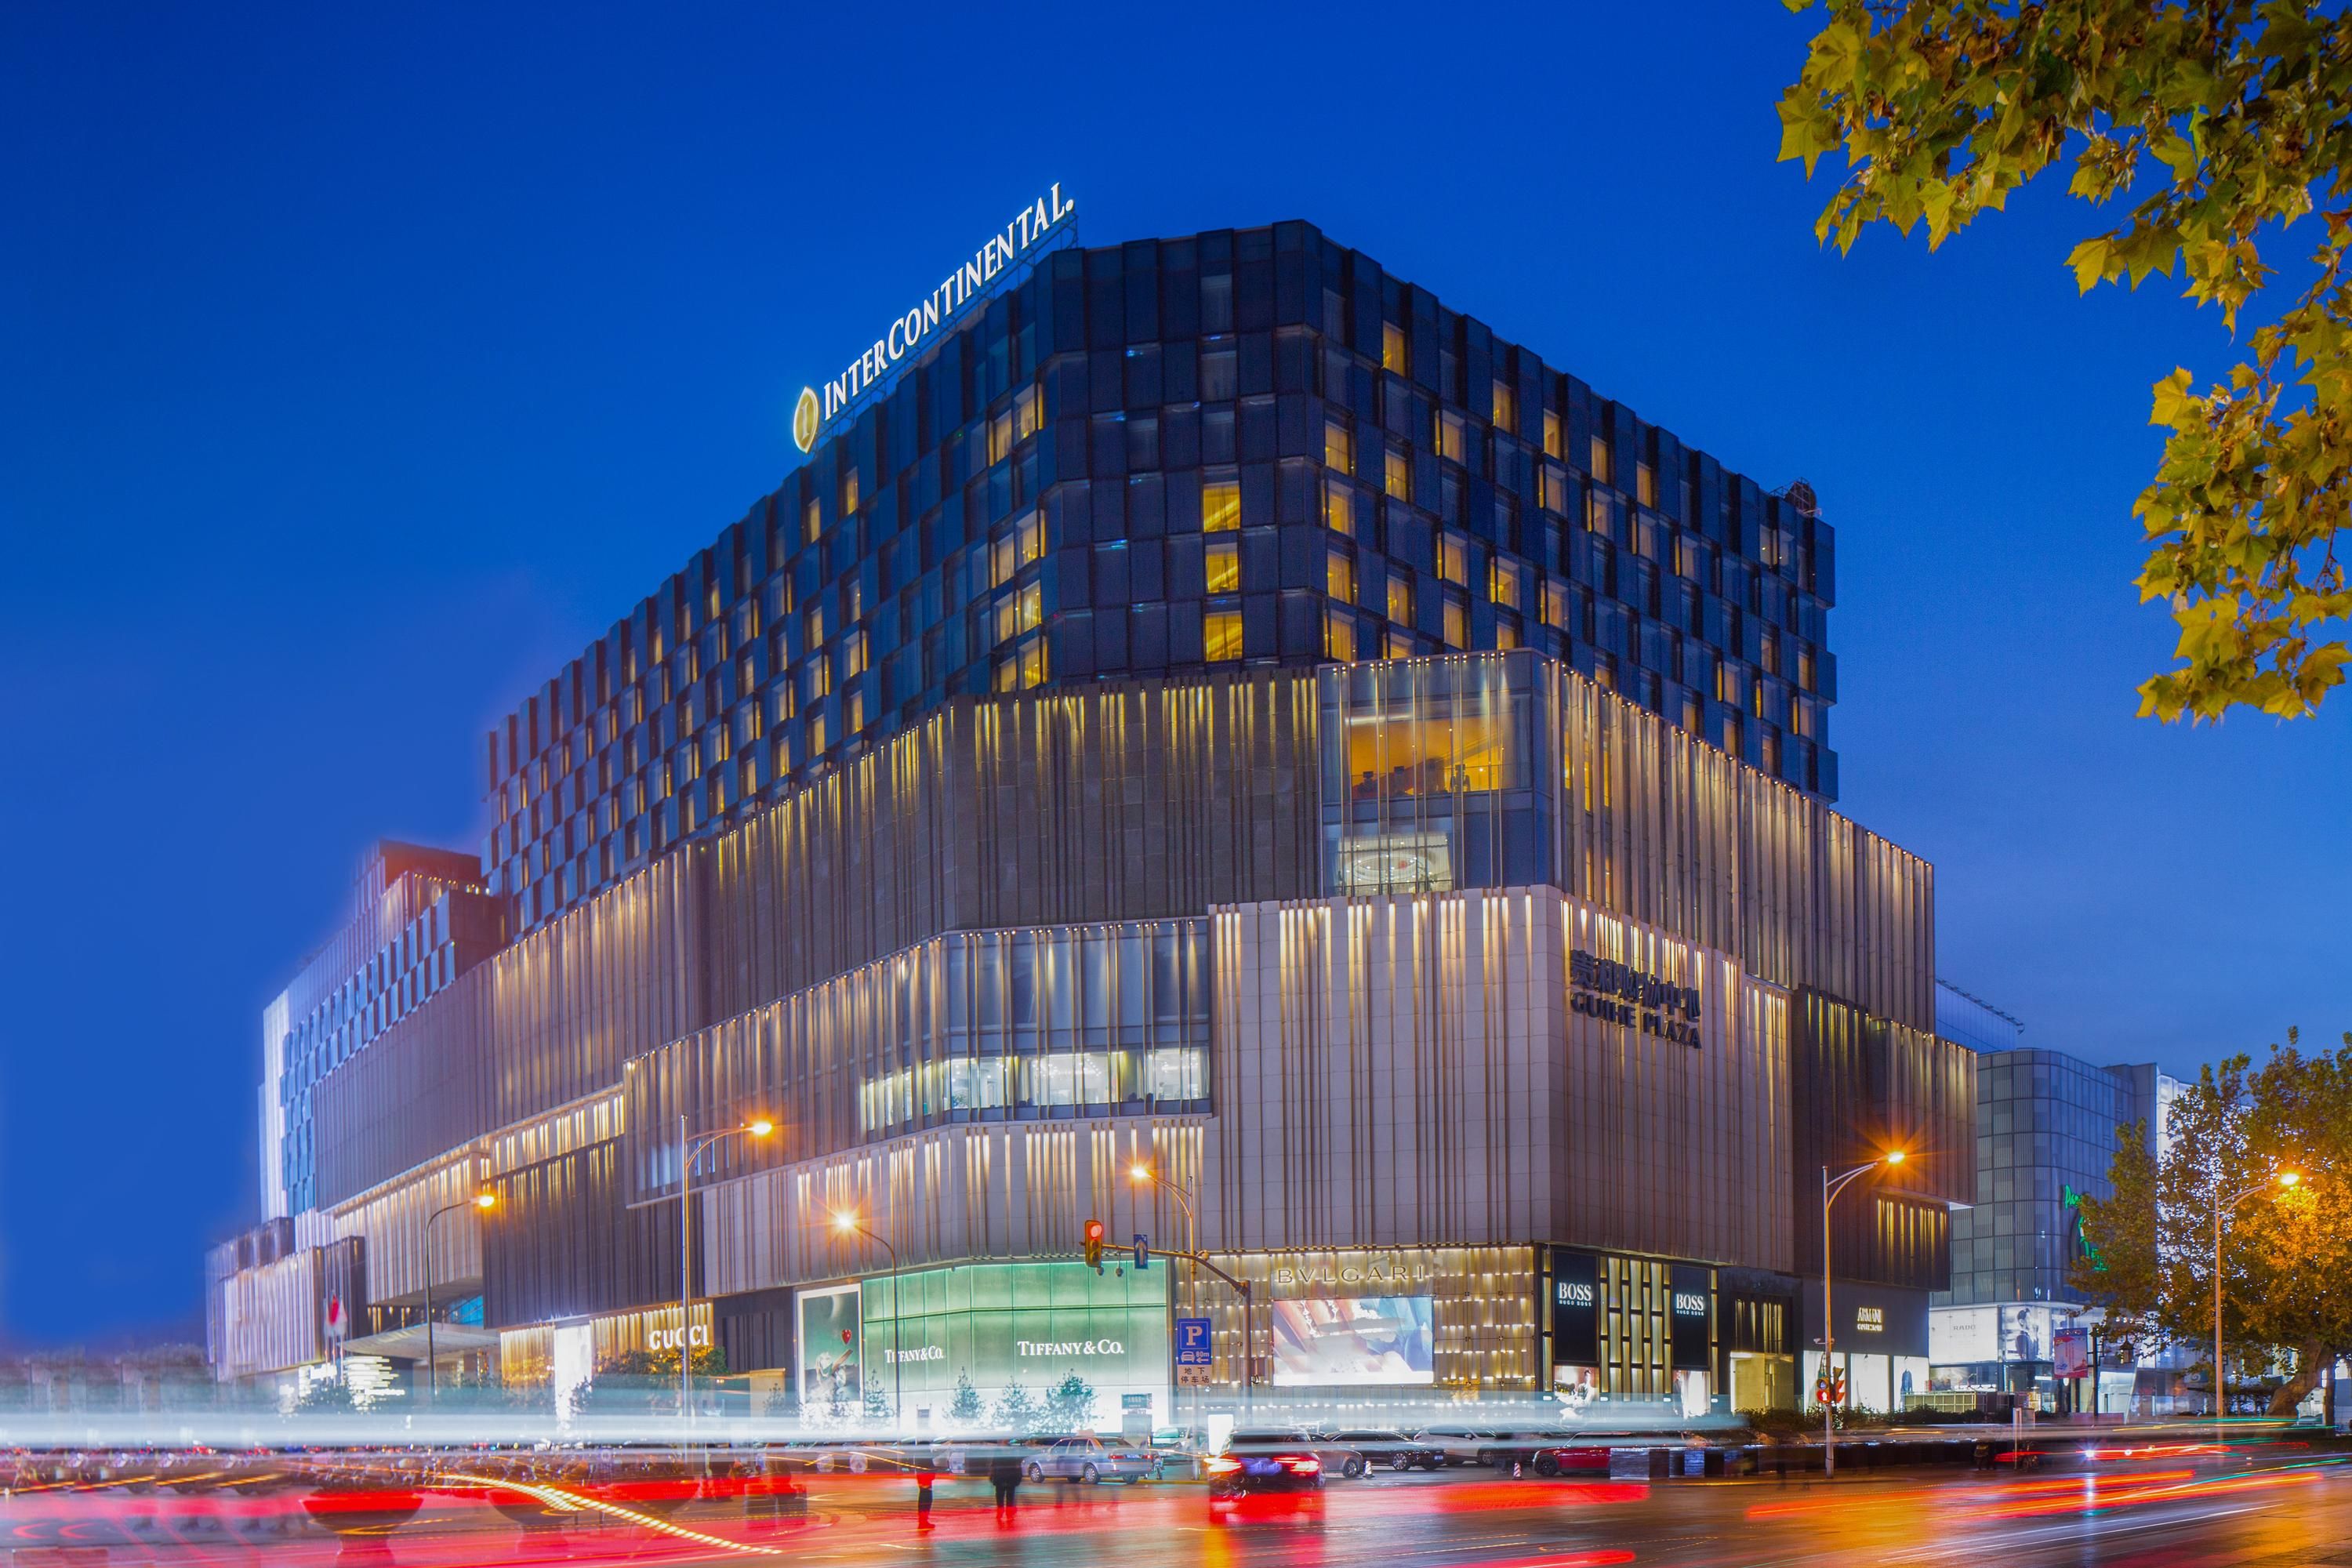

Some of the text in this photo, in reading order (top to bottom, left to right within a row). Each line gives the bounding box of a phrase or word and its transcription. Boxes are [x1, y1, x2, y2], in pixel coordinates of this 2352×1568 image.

[1570, 991, 1702, 1050] GUIHE PLAZA
[1277, 1265, 1425, 1284] BVLGARI
[1558, 1282, 1593, 1301] BOSS
[1675, 1293, 1704, 1311] BOSS
[1185, 1326, 1203, 1346] P
[1181, 1375, 1210, 1384] 停车场
